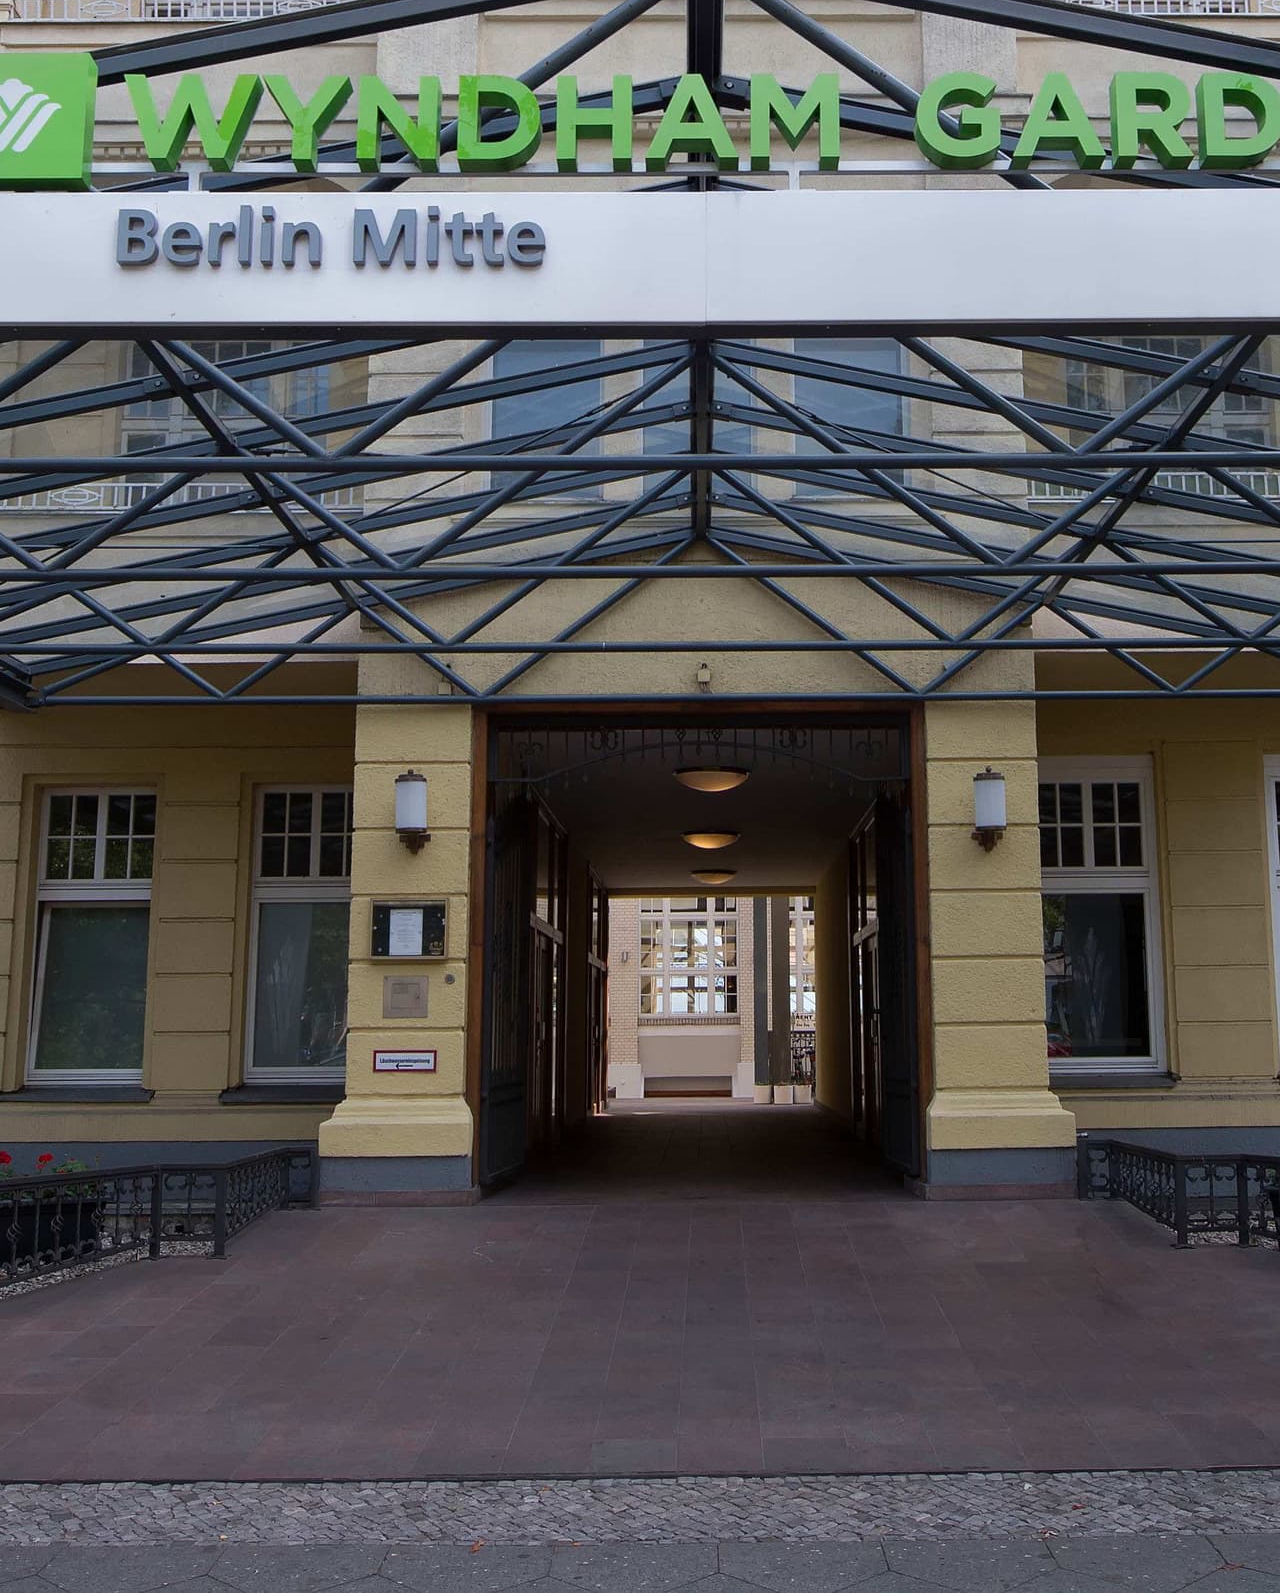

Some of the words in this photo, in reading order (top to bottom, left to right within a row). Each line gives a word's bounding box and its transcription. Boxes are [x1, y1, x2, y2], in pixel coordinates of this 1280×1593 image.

[124, 73, 840, 173] WYNDHAM
[116, 204, 323, 269] Berlin
[353, 205, 547, 268] Mitte
